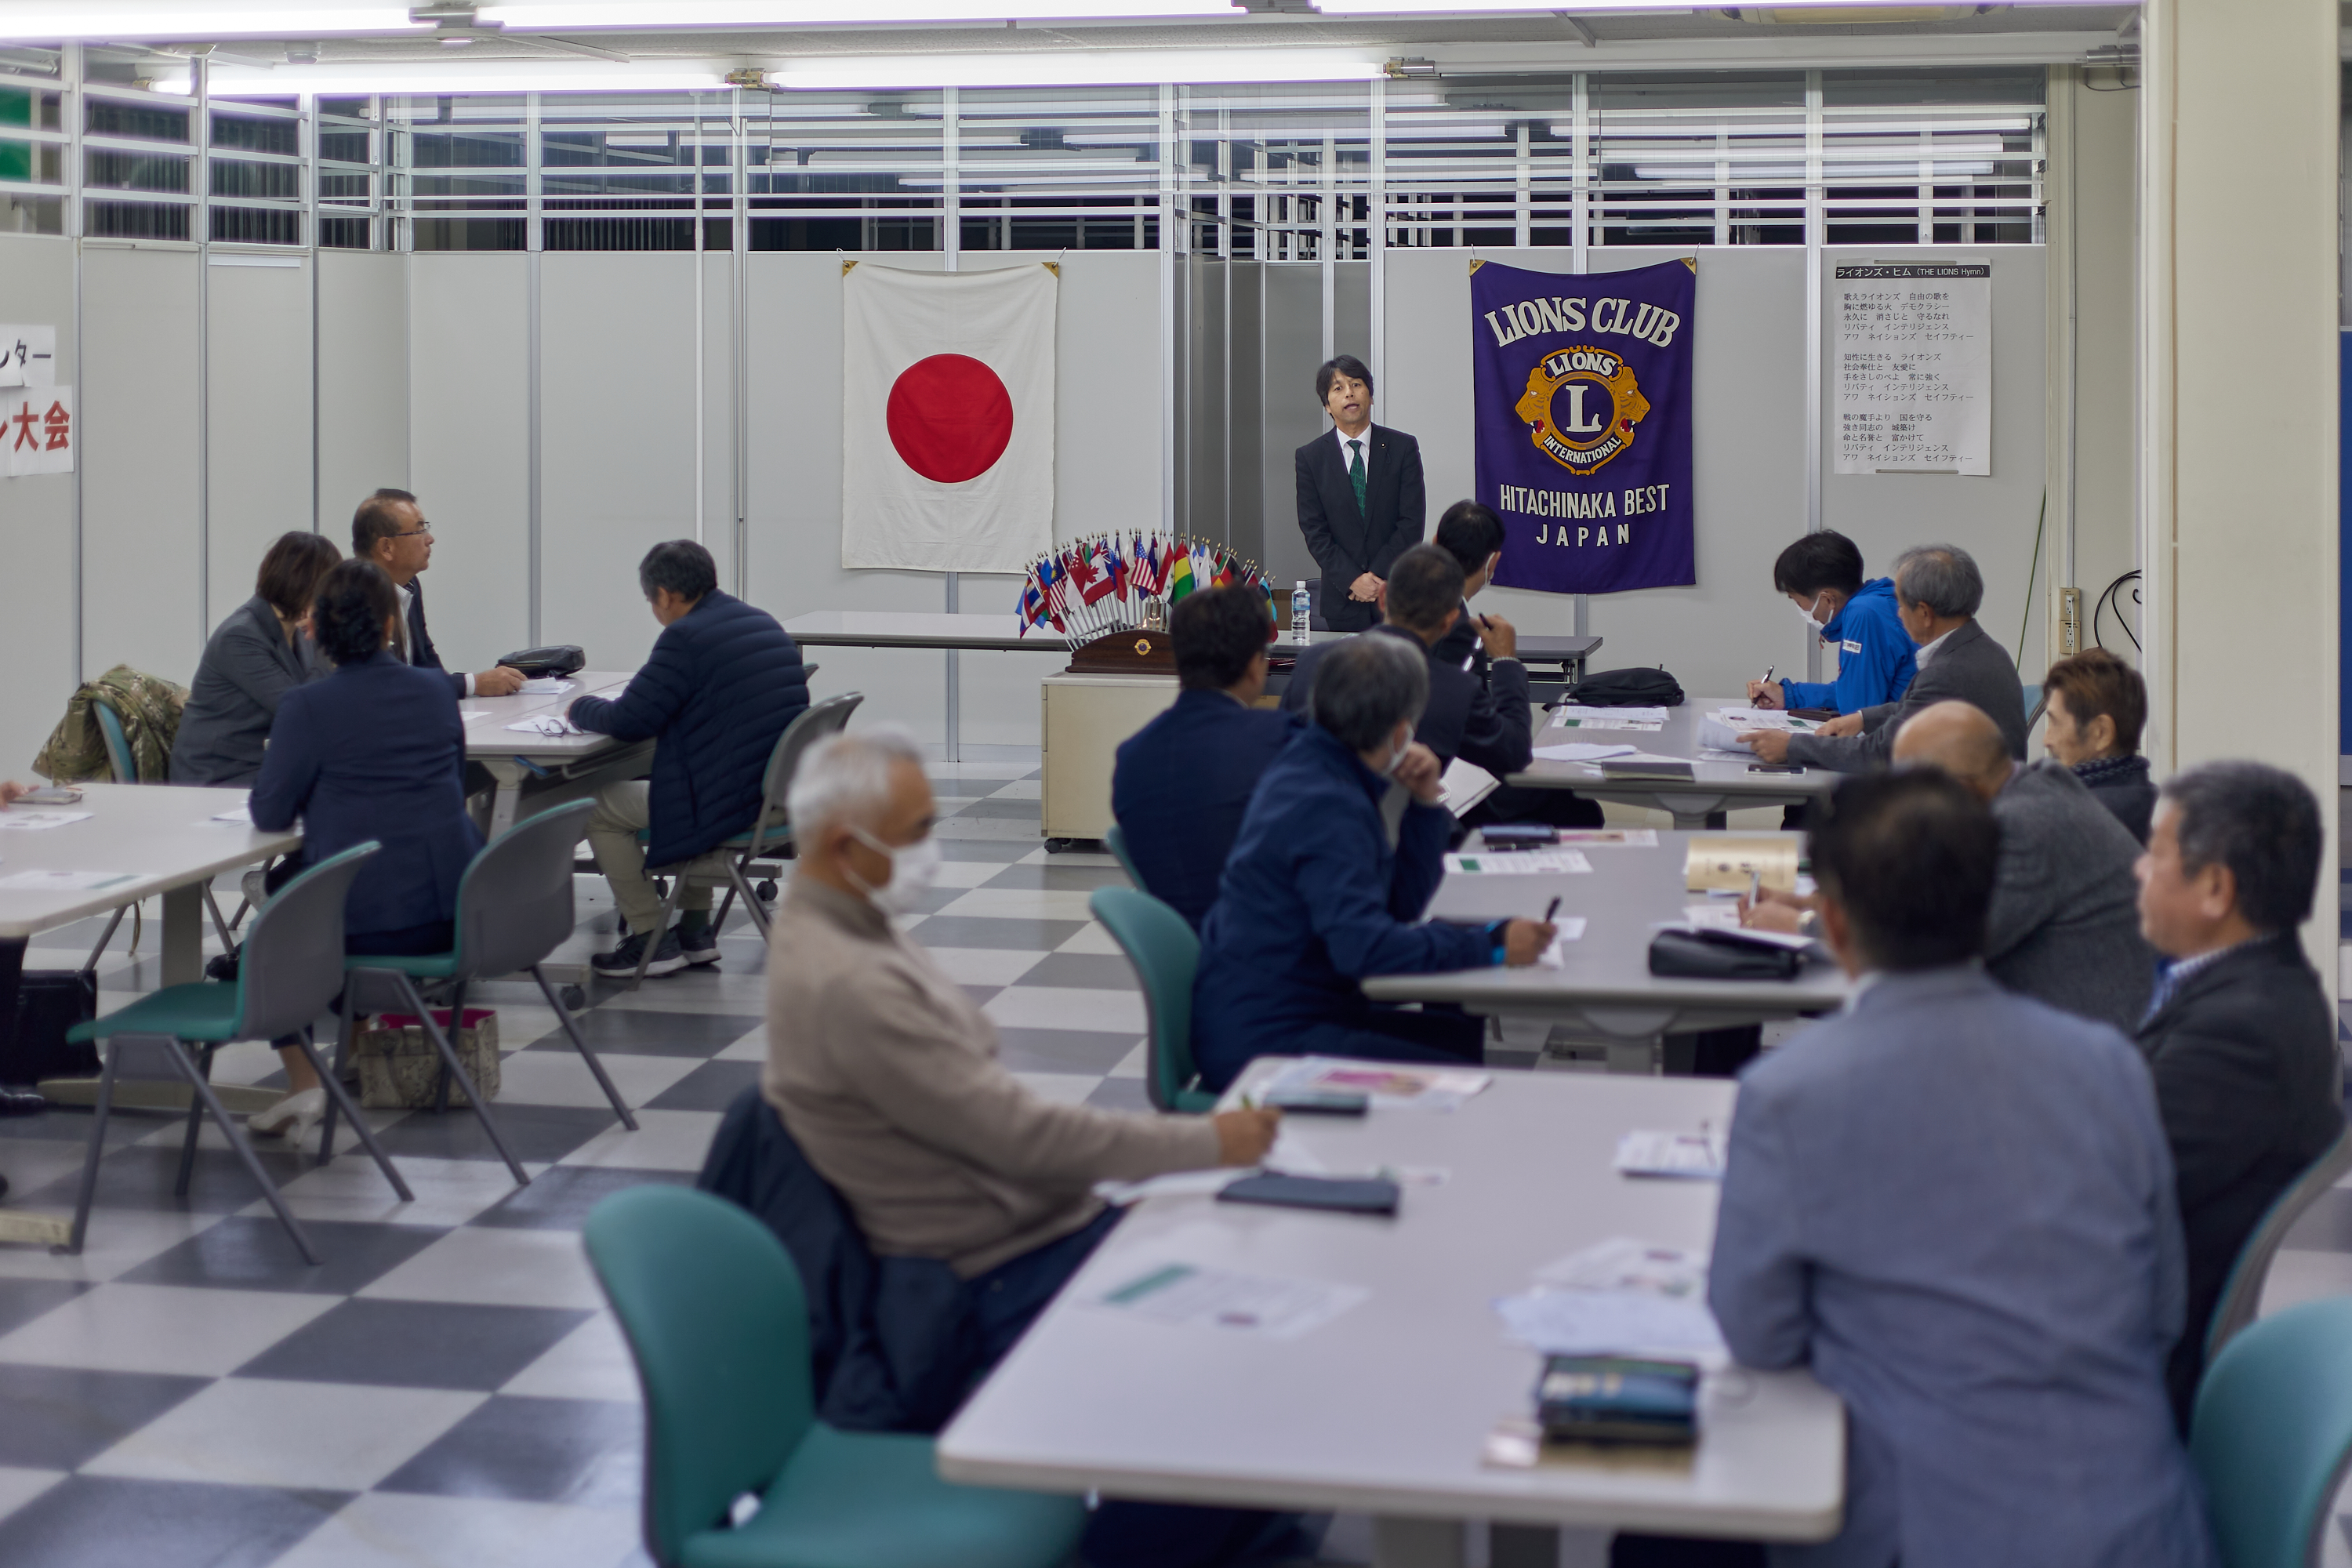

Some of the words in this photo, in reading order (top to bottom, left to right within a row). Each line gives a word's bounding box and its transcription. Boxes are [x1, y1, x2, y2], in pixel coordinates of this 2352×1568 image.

[1837, 267, 1911, 277] ライオンズ・ヒム
[1844, 292, 1900, 301] 歌えライオンズ
[1908, 292, 1950, 301] 自由の歌を
[1844, 303, 1893, 311] 胸に燃ゆる火
[1900, 303, 1950, 311] デモクラシー
[1484, 297, 1587, 347] LIONS
[1592, 297, 1680, 347] CLUB
[1548, 352, 1618, 376] LIONS
[1844, 353, 1892, 361] 知性に生きる
[1900, 353, 1942, 361] ライオンズ
[1844, 393, 1860, 401] アワ
[1867, 393, 1917, 401] ネイションズ
[1925, 393, 1974, 401] セイフティー
[1566, 385, 1602, 432] L
[1843, 413, 1891, 422] 戦の魔手より
[1900, 413, 1933, 422] 国を守る
[0, 400, 71, 453] 大会
[1544, 436, 1622, 463] INTERNATIONAL
[1843, 453, 1858, 462] アワ
[1867, 453, 1916, 462] ネイションズ
[1925, 453, 1973, 462] セイフティー
[1500, 484, 1616, 519] HITACHINAKA
[1624, 484, 1670, 516] BEST
[1536, 524, 1630, 546] JAPAN
